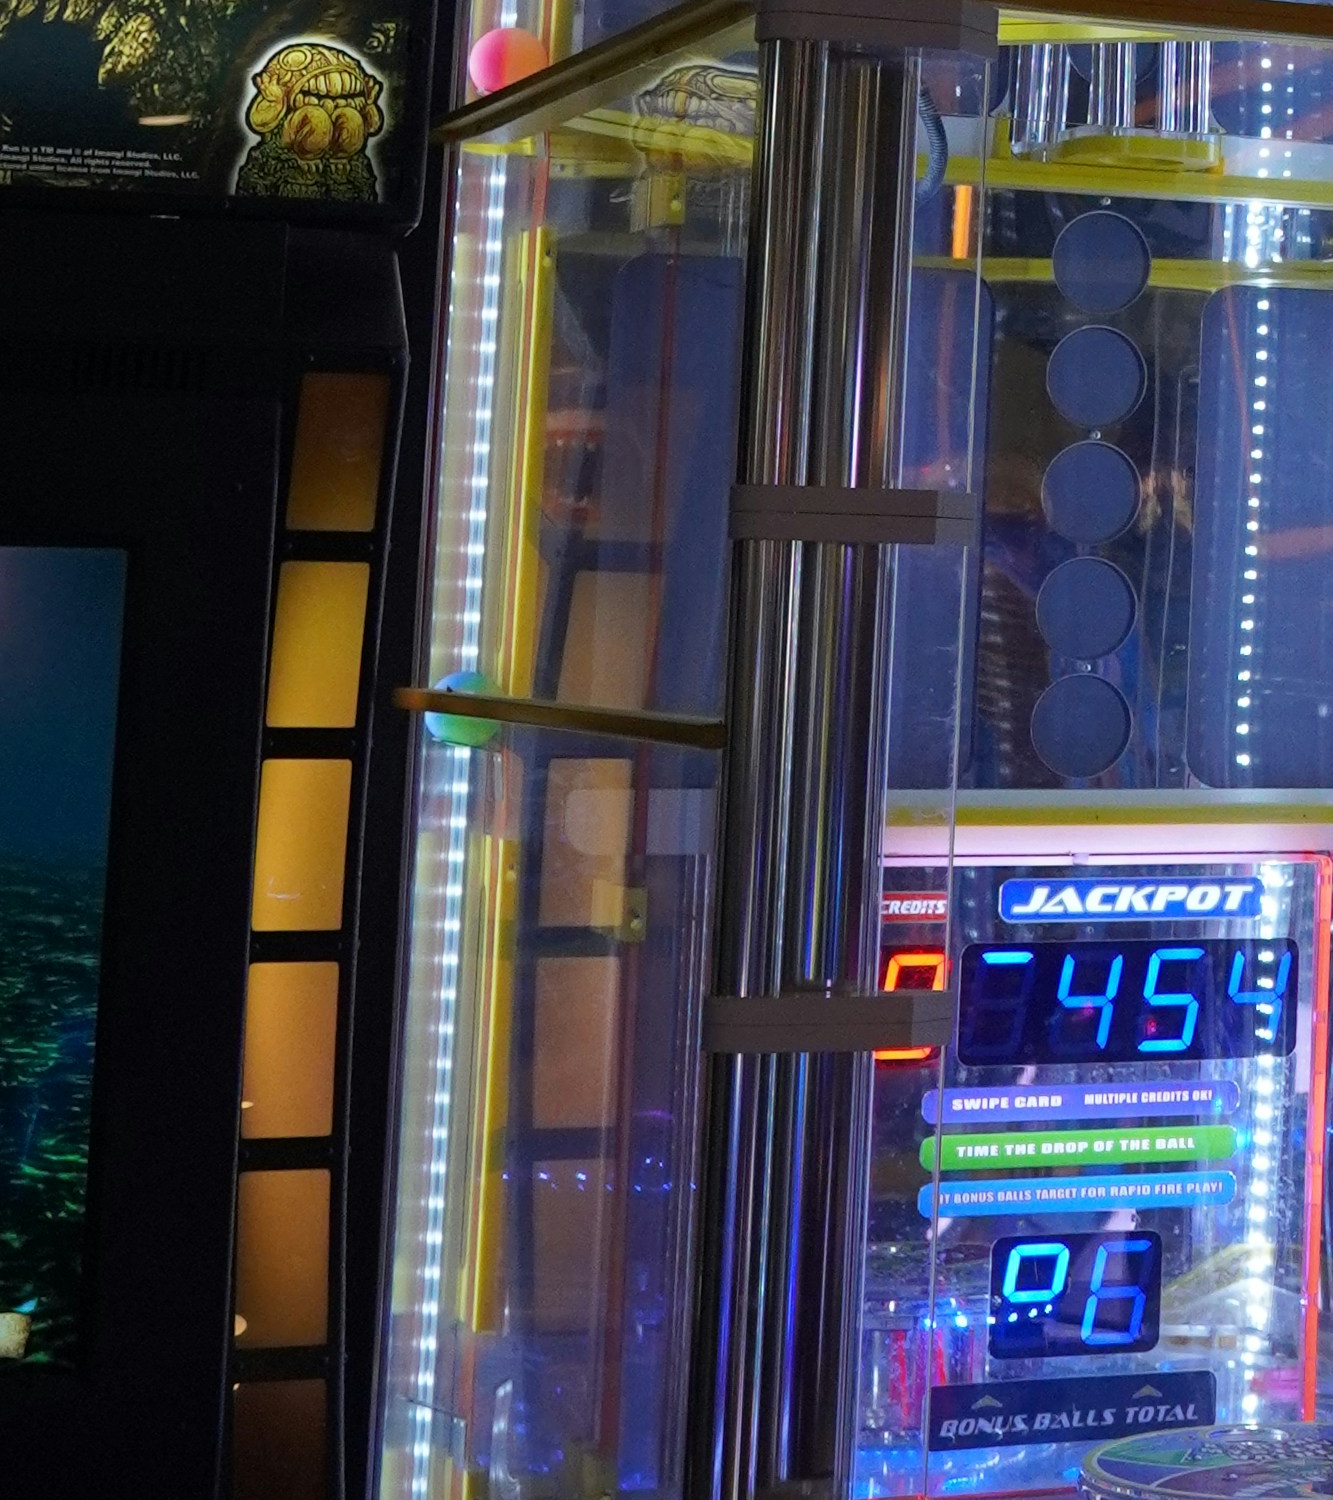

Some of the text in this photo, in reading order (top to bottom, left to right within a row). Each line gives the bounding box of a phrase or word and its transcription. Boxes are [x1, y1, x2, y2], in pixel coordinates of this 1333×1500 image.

[1010, 884, 1253, 914] JACKPOT
[951, 1089, 1213, 1111] SWIPE CARD MULTIPLE CREDITS OK!
[956, 1137, 1195, 1158] TIME THE DROP OF THE BALL
[953, 1191, 995, 1204] BONUS
[997, 1189, 1032, 1202] BALLS
[1035, 1187, 1078, 1200] TARGET
[1081, 1186, 1106, 1198] FOR
[1110, 1184, 1151, 1197] RAPID
[1154, 1183, 1183, 1195] FIRE
[1186, 1181, 1223, 1194] PLAY!
[940, 1402, 1200, 1439] BONUS BALLS TOTAL
